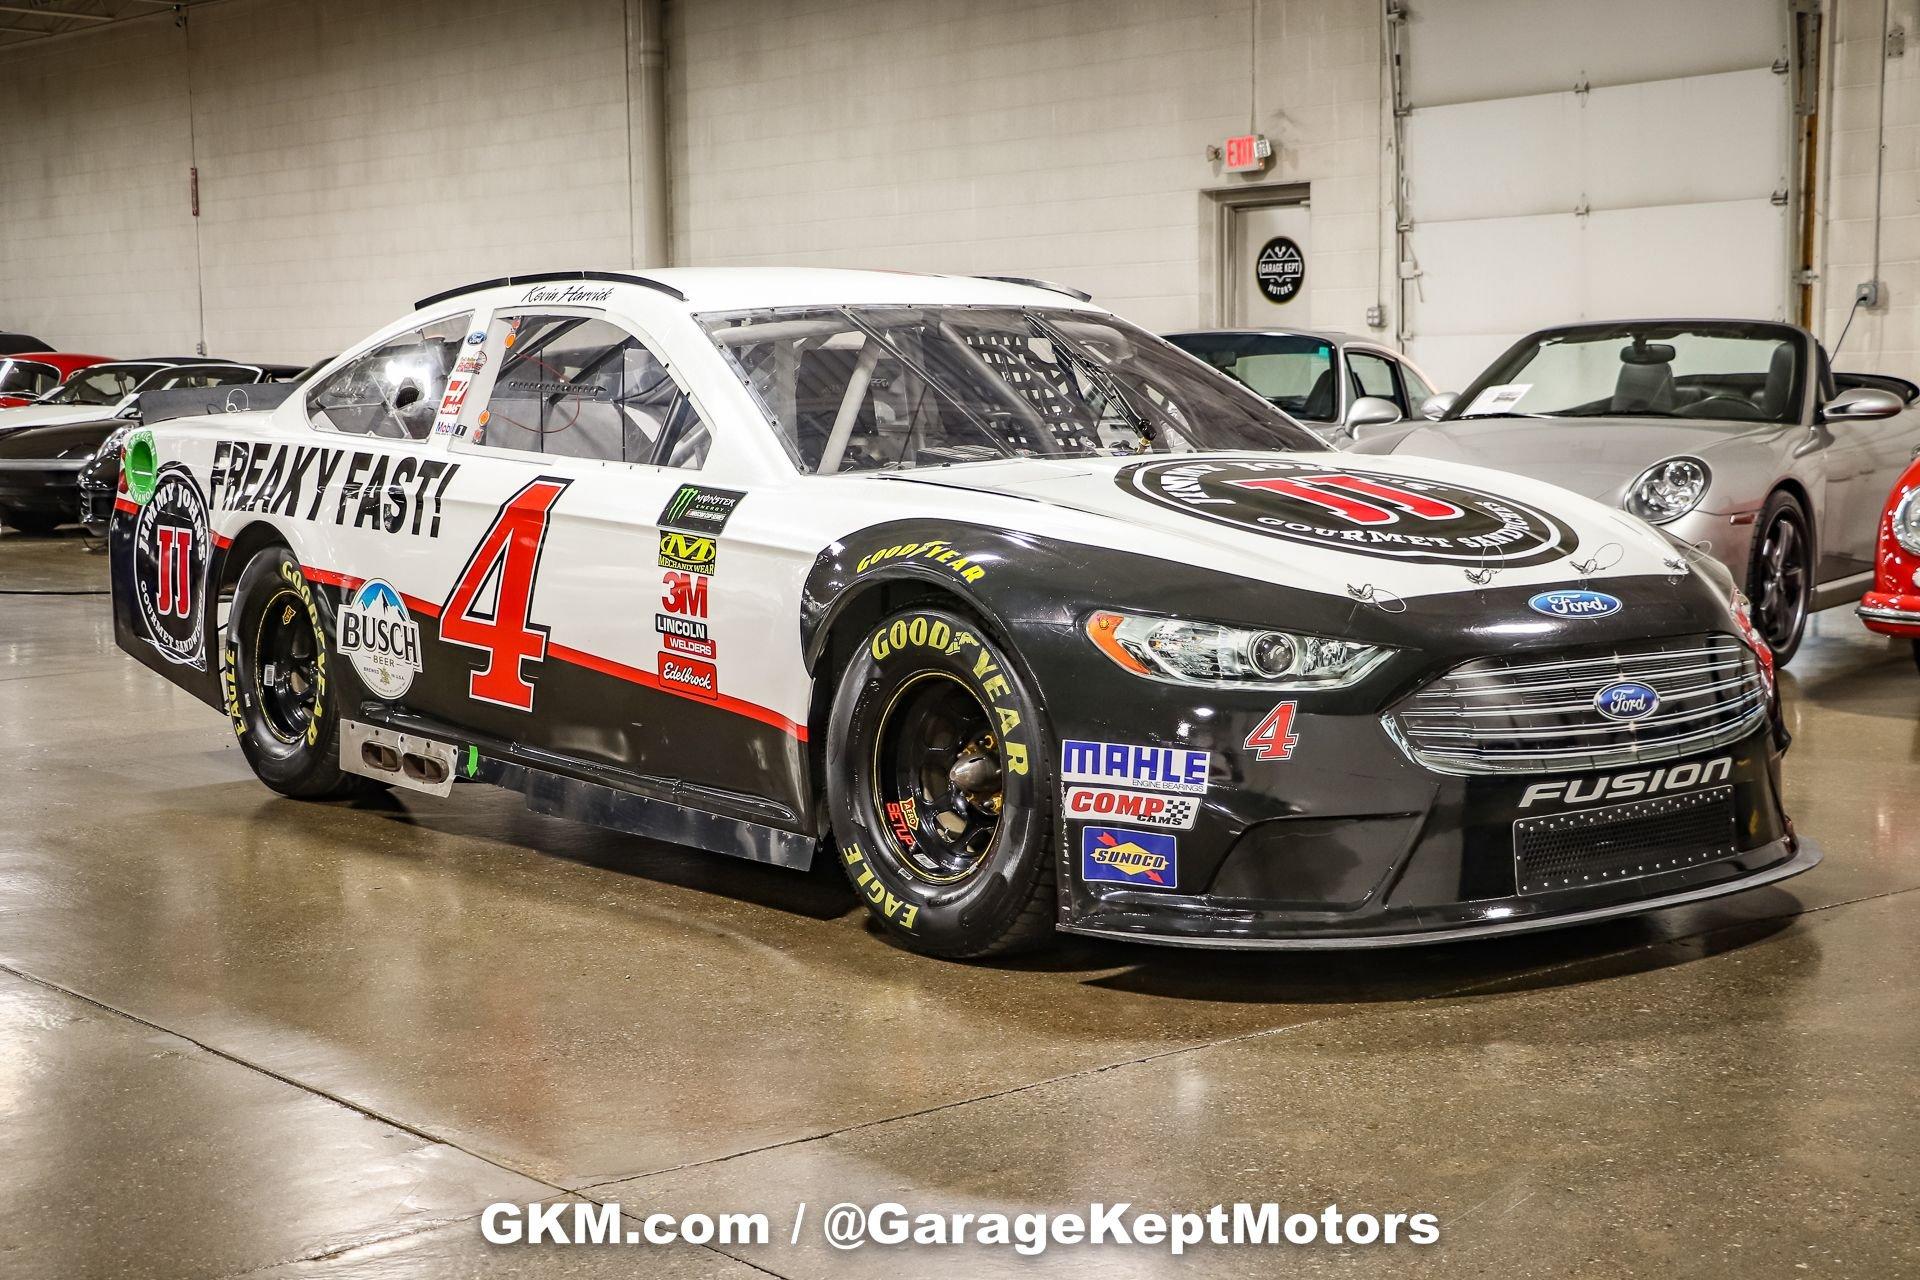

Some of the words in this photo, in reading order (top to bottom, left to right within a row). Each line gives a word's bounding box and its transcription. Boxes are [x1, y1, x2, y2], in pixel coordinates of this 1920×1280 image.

[1261, 262, 1284, 274] GARAGE
[1284, 261, 1299, 273] KEPT
[520, 285, 559, 303] Kevin
[557, 285, 615, 303] Harvick
[1267, 283, 1293, 296] MOTORS
[128, 481, 155, 504] ETHANOL
[209, 440, 345, 522] FREAKY
[335, 451, 461, 538] FAST!
[1160, 464, 1237, 505] JIMMY
[694, 493, 737, 508] MONSTER
[695, 504, 725, 513] ENERGY
[138, 482, 176, 555] JIMMY
[1256, 517, 1454, 548] GOURMET
[658, 554, 694, 572] MECHANIX
[693, 563, 715, 575] WEAR
[856, 539, 987, 585] GOODYEAR
[438, 475, 575, 713] 4
[661, 570, 709, 619] 3M
[1545, 590, 1609, 615] Ford
[140, 579, 175, 649] GOURMET
[657, 615, 705, 640] LINCOLN
[341, 611, 419, 664] BUSCH
[669, 637, 712, 656] WELDERS
[281, 560, 326, 747] GOODYEAR
[373, 655, 395, 668] BEER
[662, 661, 712, 690] Edelbrock
[225, 648, 248, 737] EAGLE
[870, 616, 1030, 777] GOODYEAR
[1609, 688, 1647, 714] Ford
[1243, 699, 1300, 762] 4
[1062, 740, 1207, 784] MAHLE
[1132, 780, 1161, 789] ENGINE
[1162, 782, 1204, 793] BEARINGS
[1518, 757, 1733, 808] FUSION
[903, 802, 917, 825] AERO
[1070, 791, 1165, 817] COMP
[886, 802, 914, 848] SETUP
[1136, 813, 1183, 826] CAMS
[1095, 849, 1166, 869] SUNOCO
[842, 842, 920, 930] EAGLE
